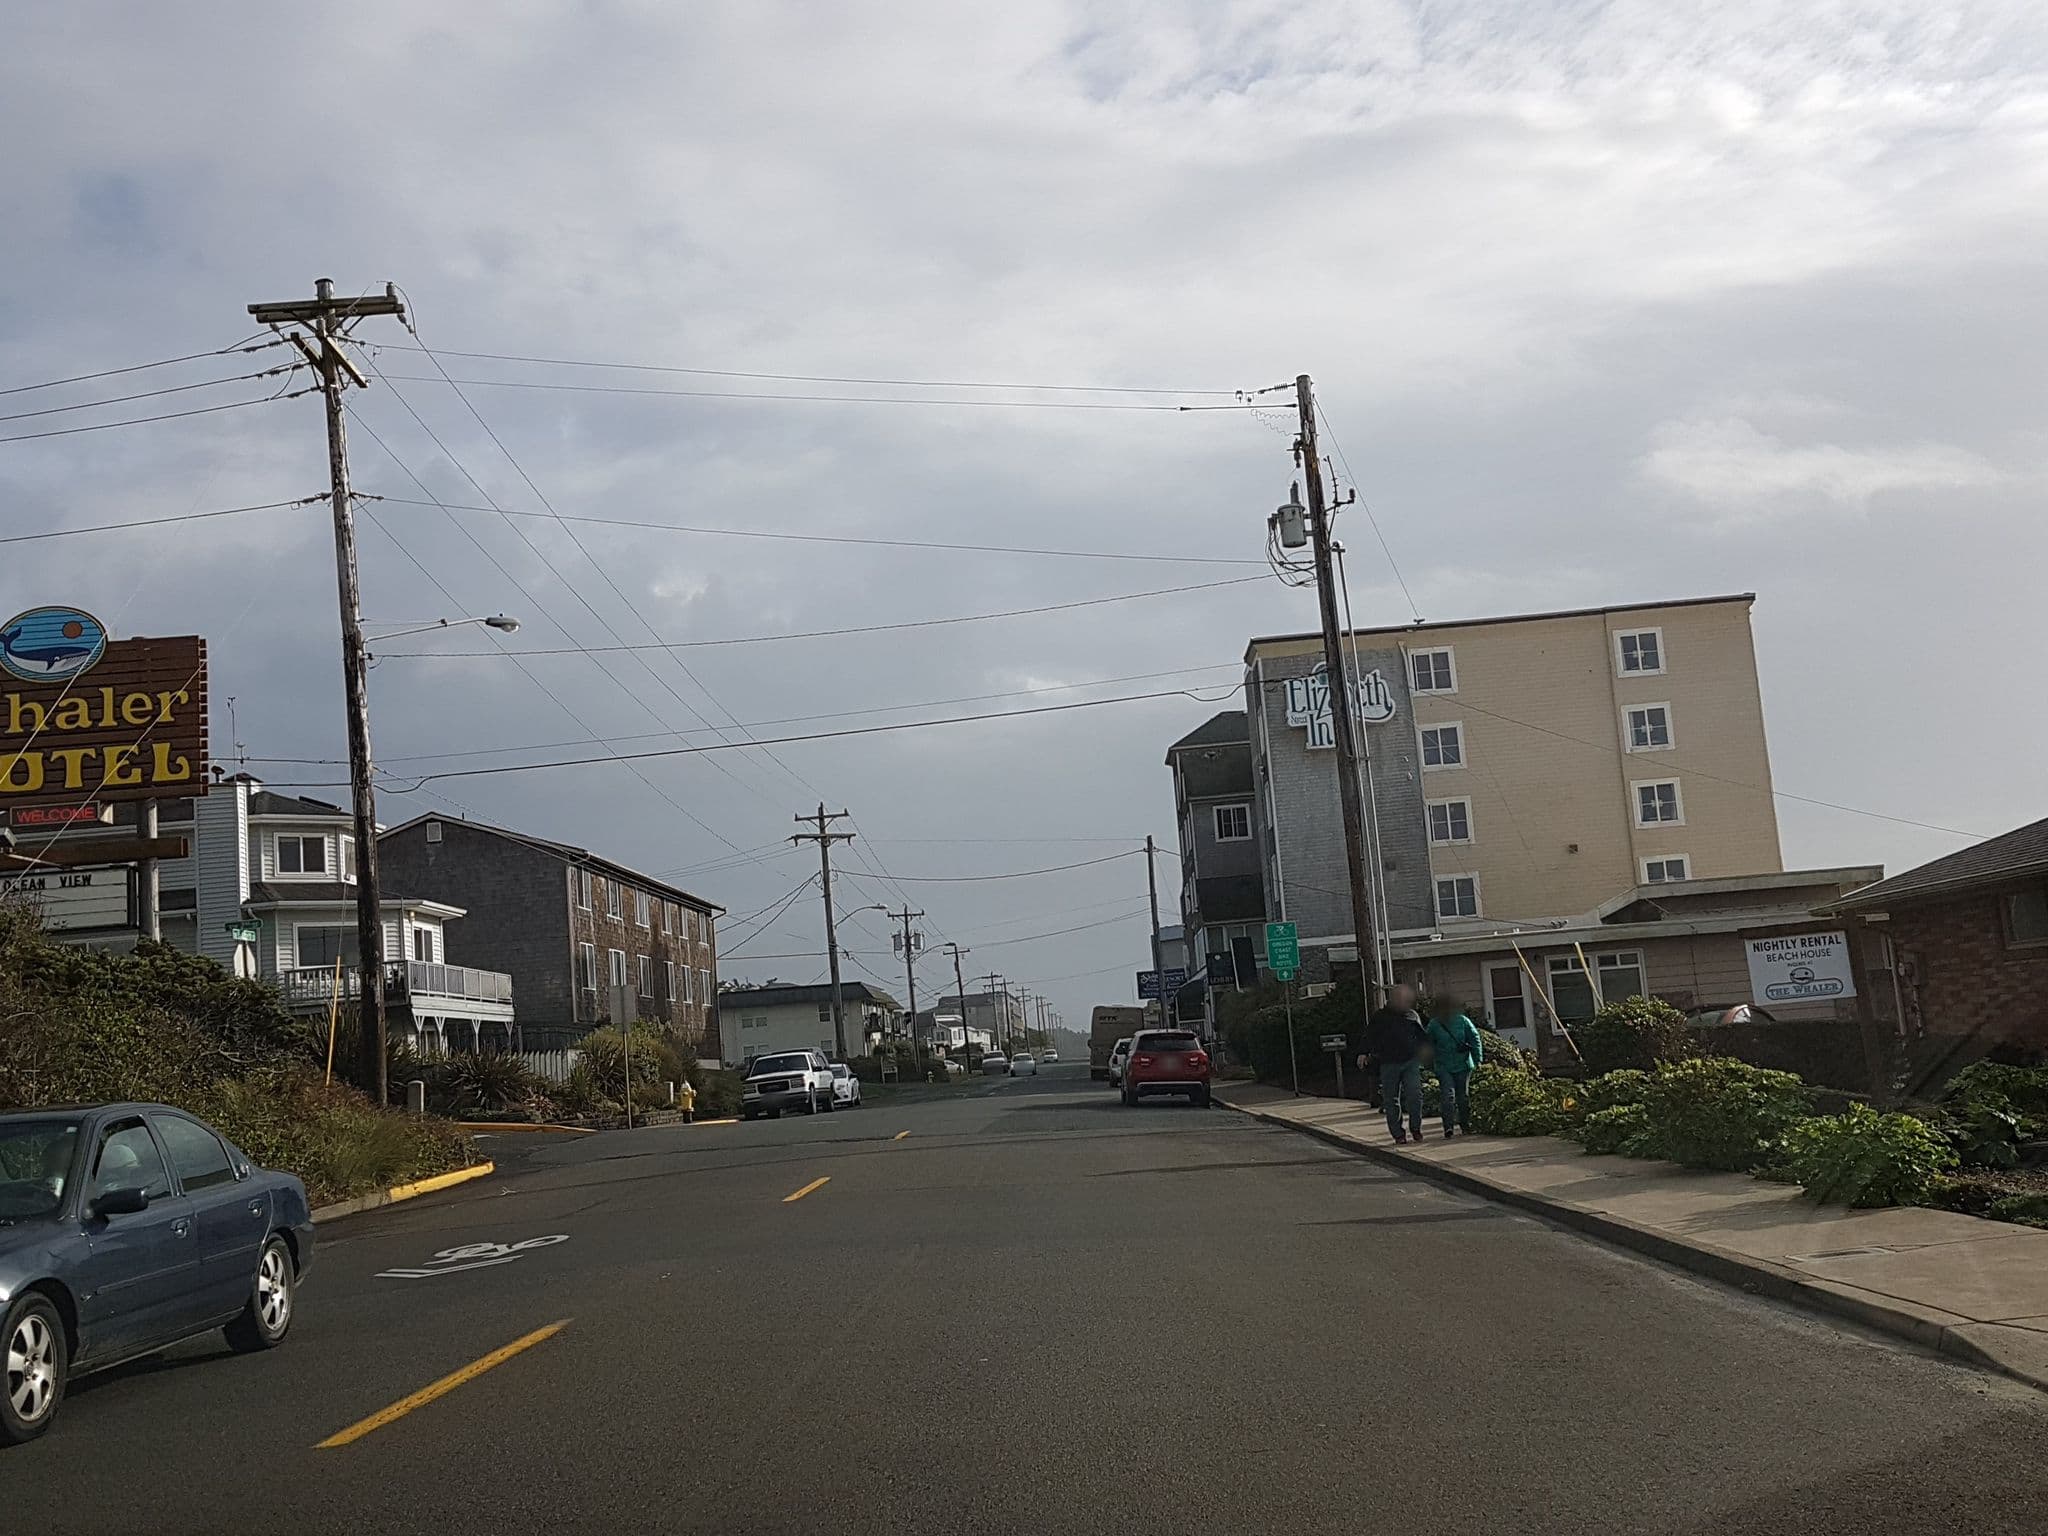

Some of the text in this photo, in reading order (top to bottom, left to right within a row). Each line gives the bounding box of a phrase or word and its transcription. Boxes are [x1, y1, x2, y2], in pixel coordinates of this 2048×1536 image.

[1287, 671, 1394, 721] Elizeth
[4, 687, 189, 734] haler
[1309, 713, 1334, 747] In
[0, 742, 190, 792] OTEL
[17, 806, 95, 823] WELCOME
[3, 873, 92, 892] OCEAN VIEW
[1753, 934, 1842, 952] NIGHTLY RENTAL
[1766, 947, 1832, 963] BEACH HOUSE
[1768, 982, 1839, 997] THE WHALER
